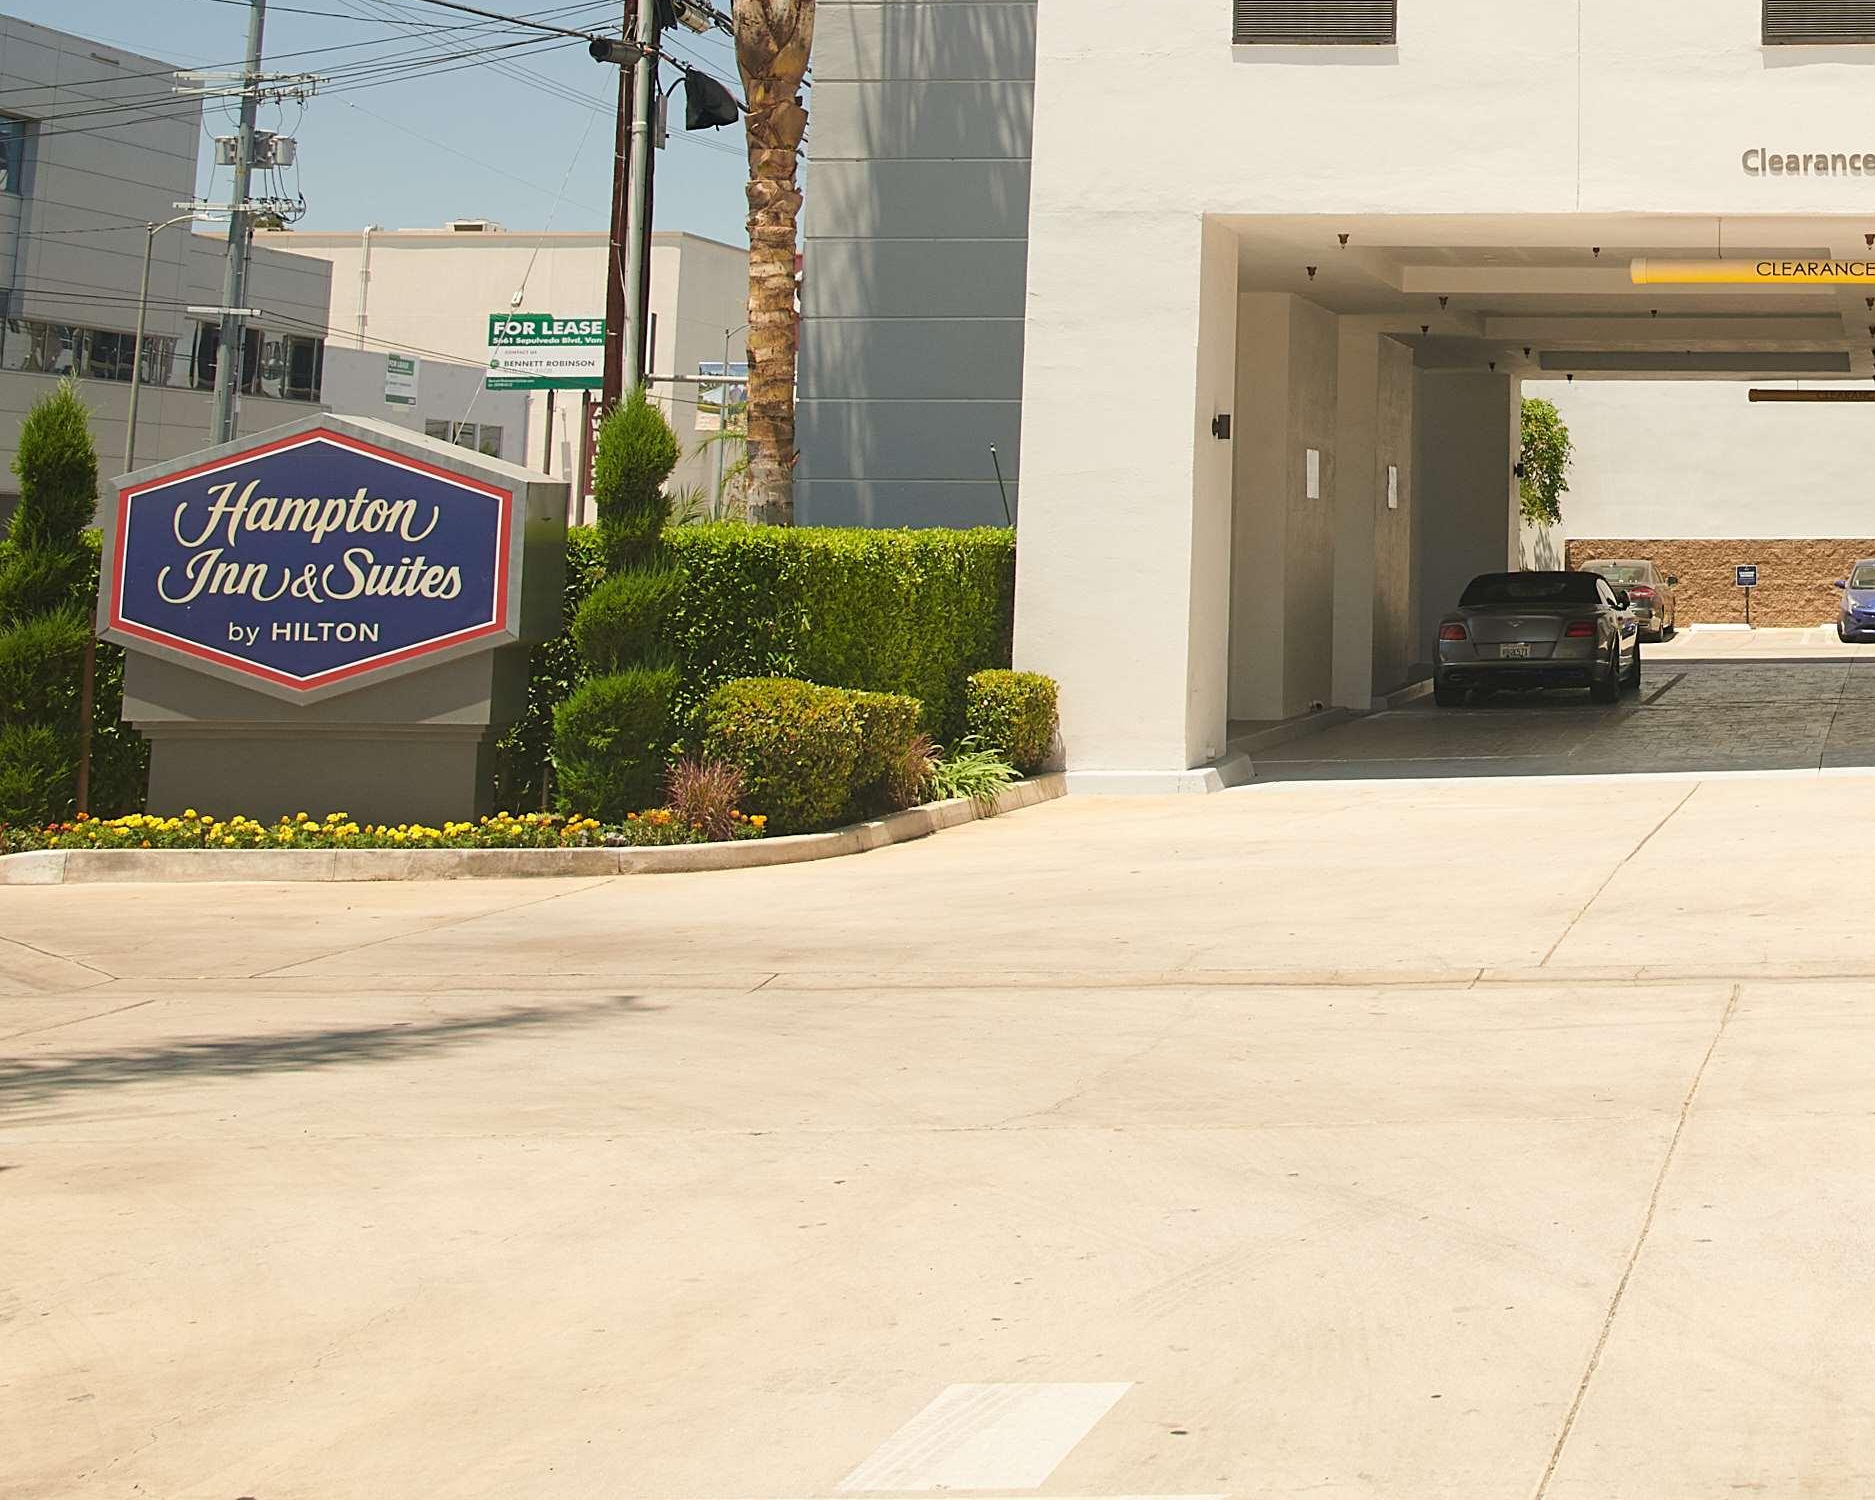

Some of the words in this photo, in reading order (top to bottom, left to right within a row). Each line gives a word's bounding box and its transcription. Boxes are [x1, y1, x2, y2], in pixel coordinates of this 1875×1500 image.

[1756, 261, 1875, 277] CLEARANCE
[493, 321, 536, 335] FOR
[541, 321, 603, 335] LEASE
[515, 337, 560, 345] Sepulveda
[173, 479, 440, 548] Hampton
[157, 547, 291, 605] Inn
[291, 562, 325, 603] &
[322, 547, 463, 601] Suites
[228, 622, 260, 647] by
[271, 622, 380, 643] HILTON
